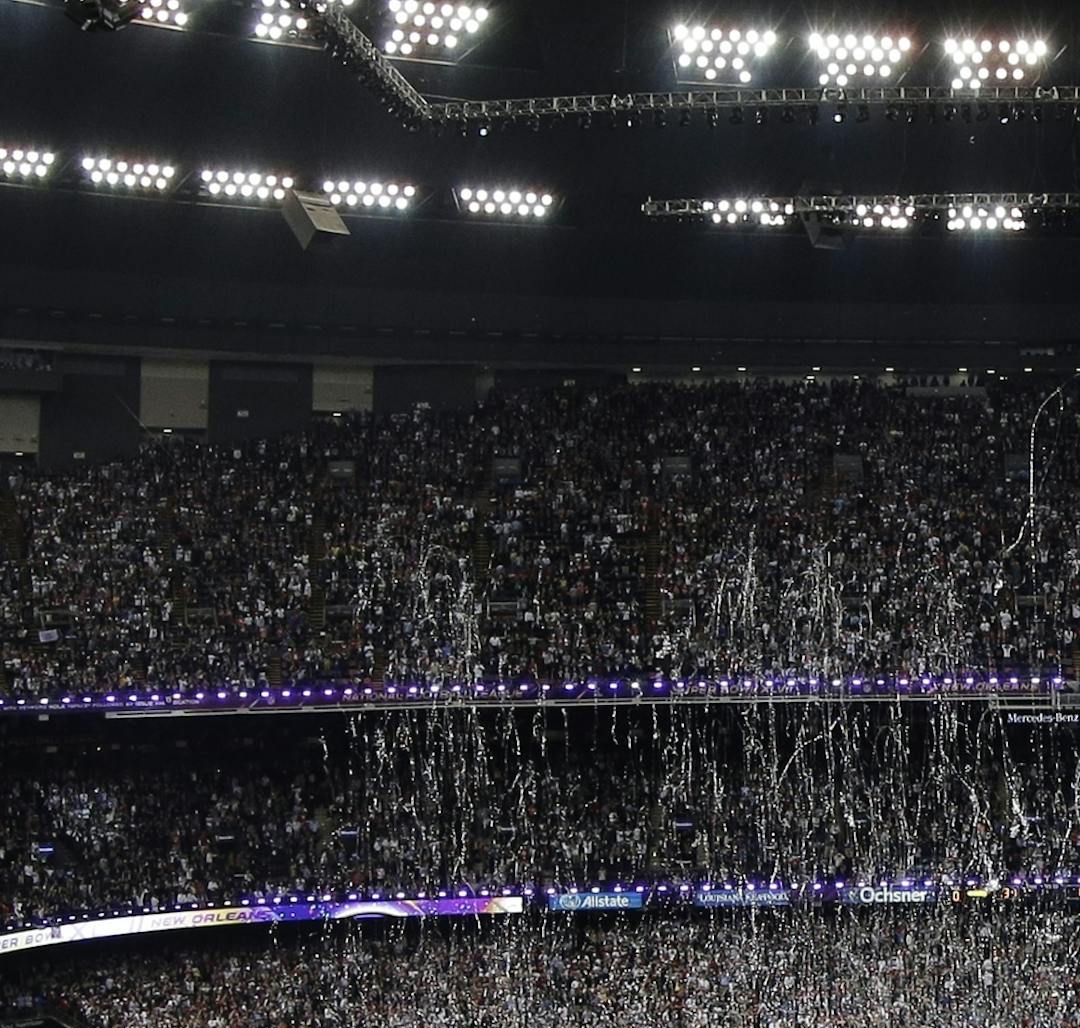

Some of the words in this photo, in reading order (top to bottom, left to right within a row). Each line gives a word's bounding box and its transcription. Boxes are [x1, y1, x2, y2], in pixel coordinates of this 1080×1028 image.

[1007, 712, 1079, 723] Mercedes-Benz
[582, 895, 629, 908] Allstate
[859, 887, 928, 903] Ochsner
